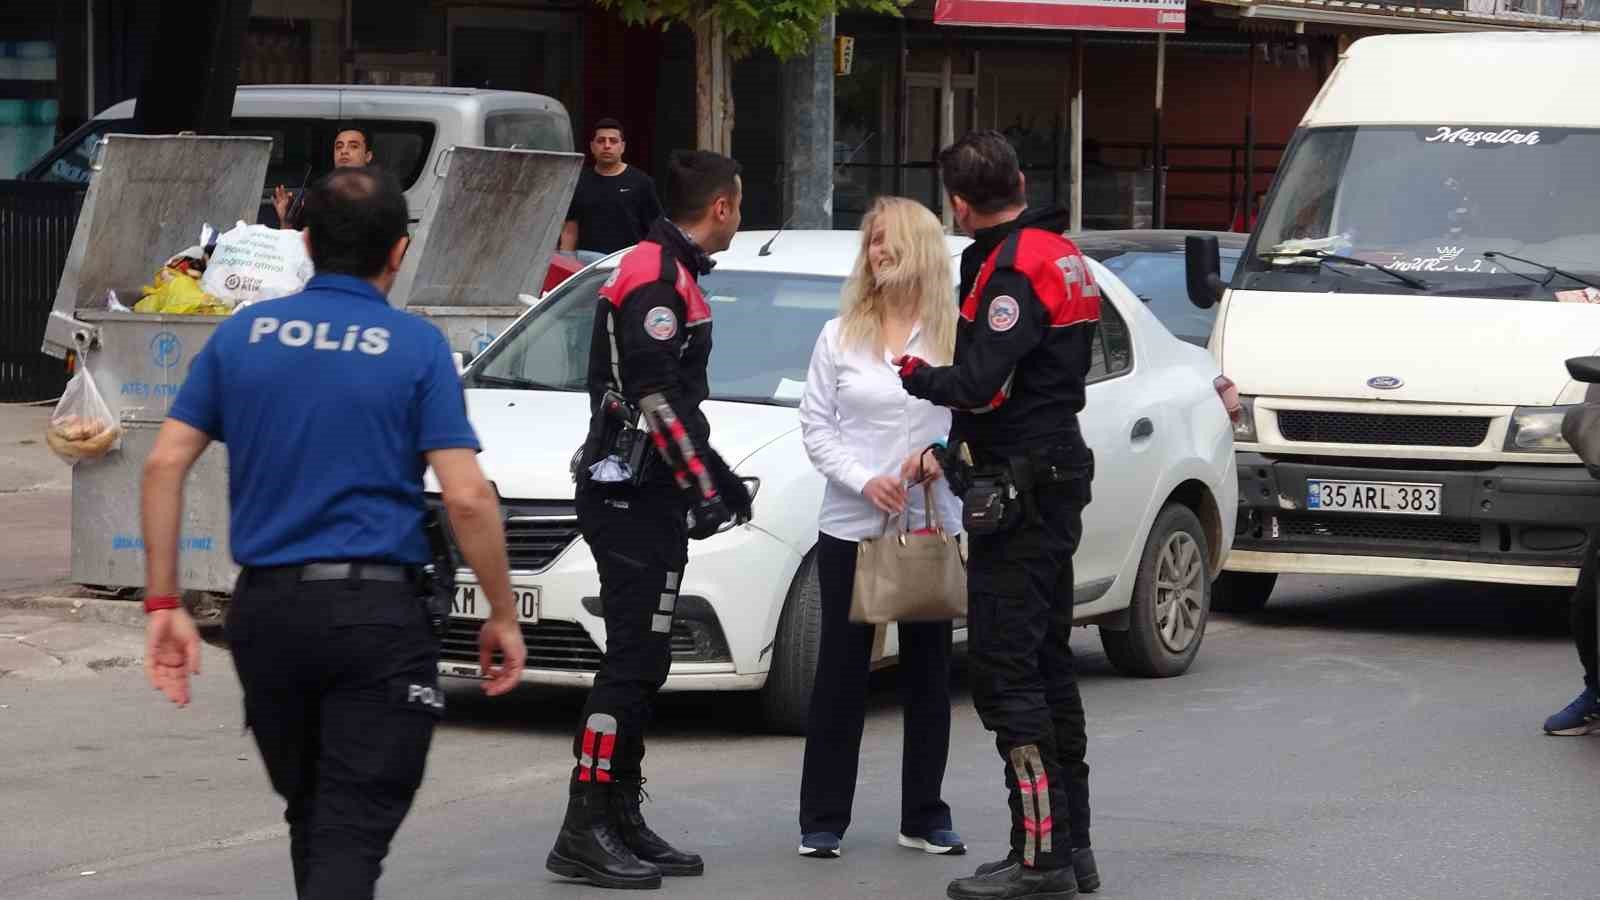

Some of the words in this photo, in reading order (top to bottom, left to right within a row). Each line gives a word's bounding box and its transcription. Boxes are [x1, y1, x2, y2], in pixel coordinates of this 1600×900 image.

[1425, 126, 1541, 146] Maşallah
[1322, 484, 1348, 507] 35
[1352, 486, 1391, 510] ARL
[1397, 488, 1437, 511] 383
